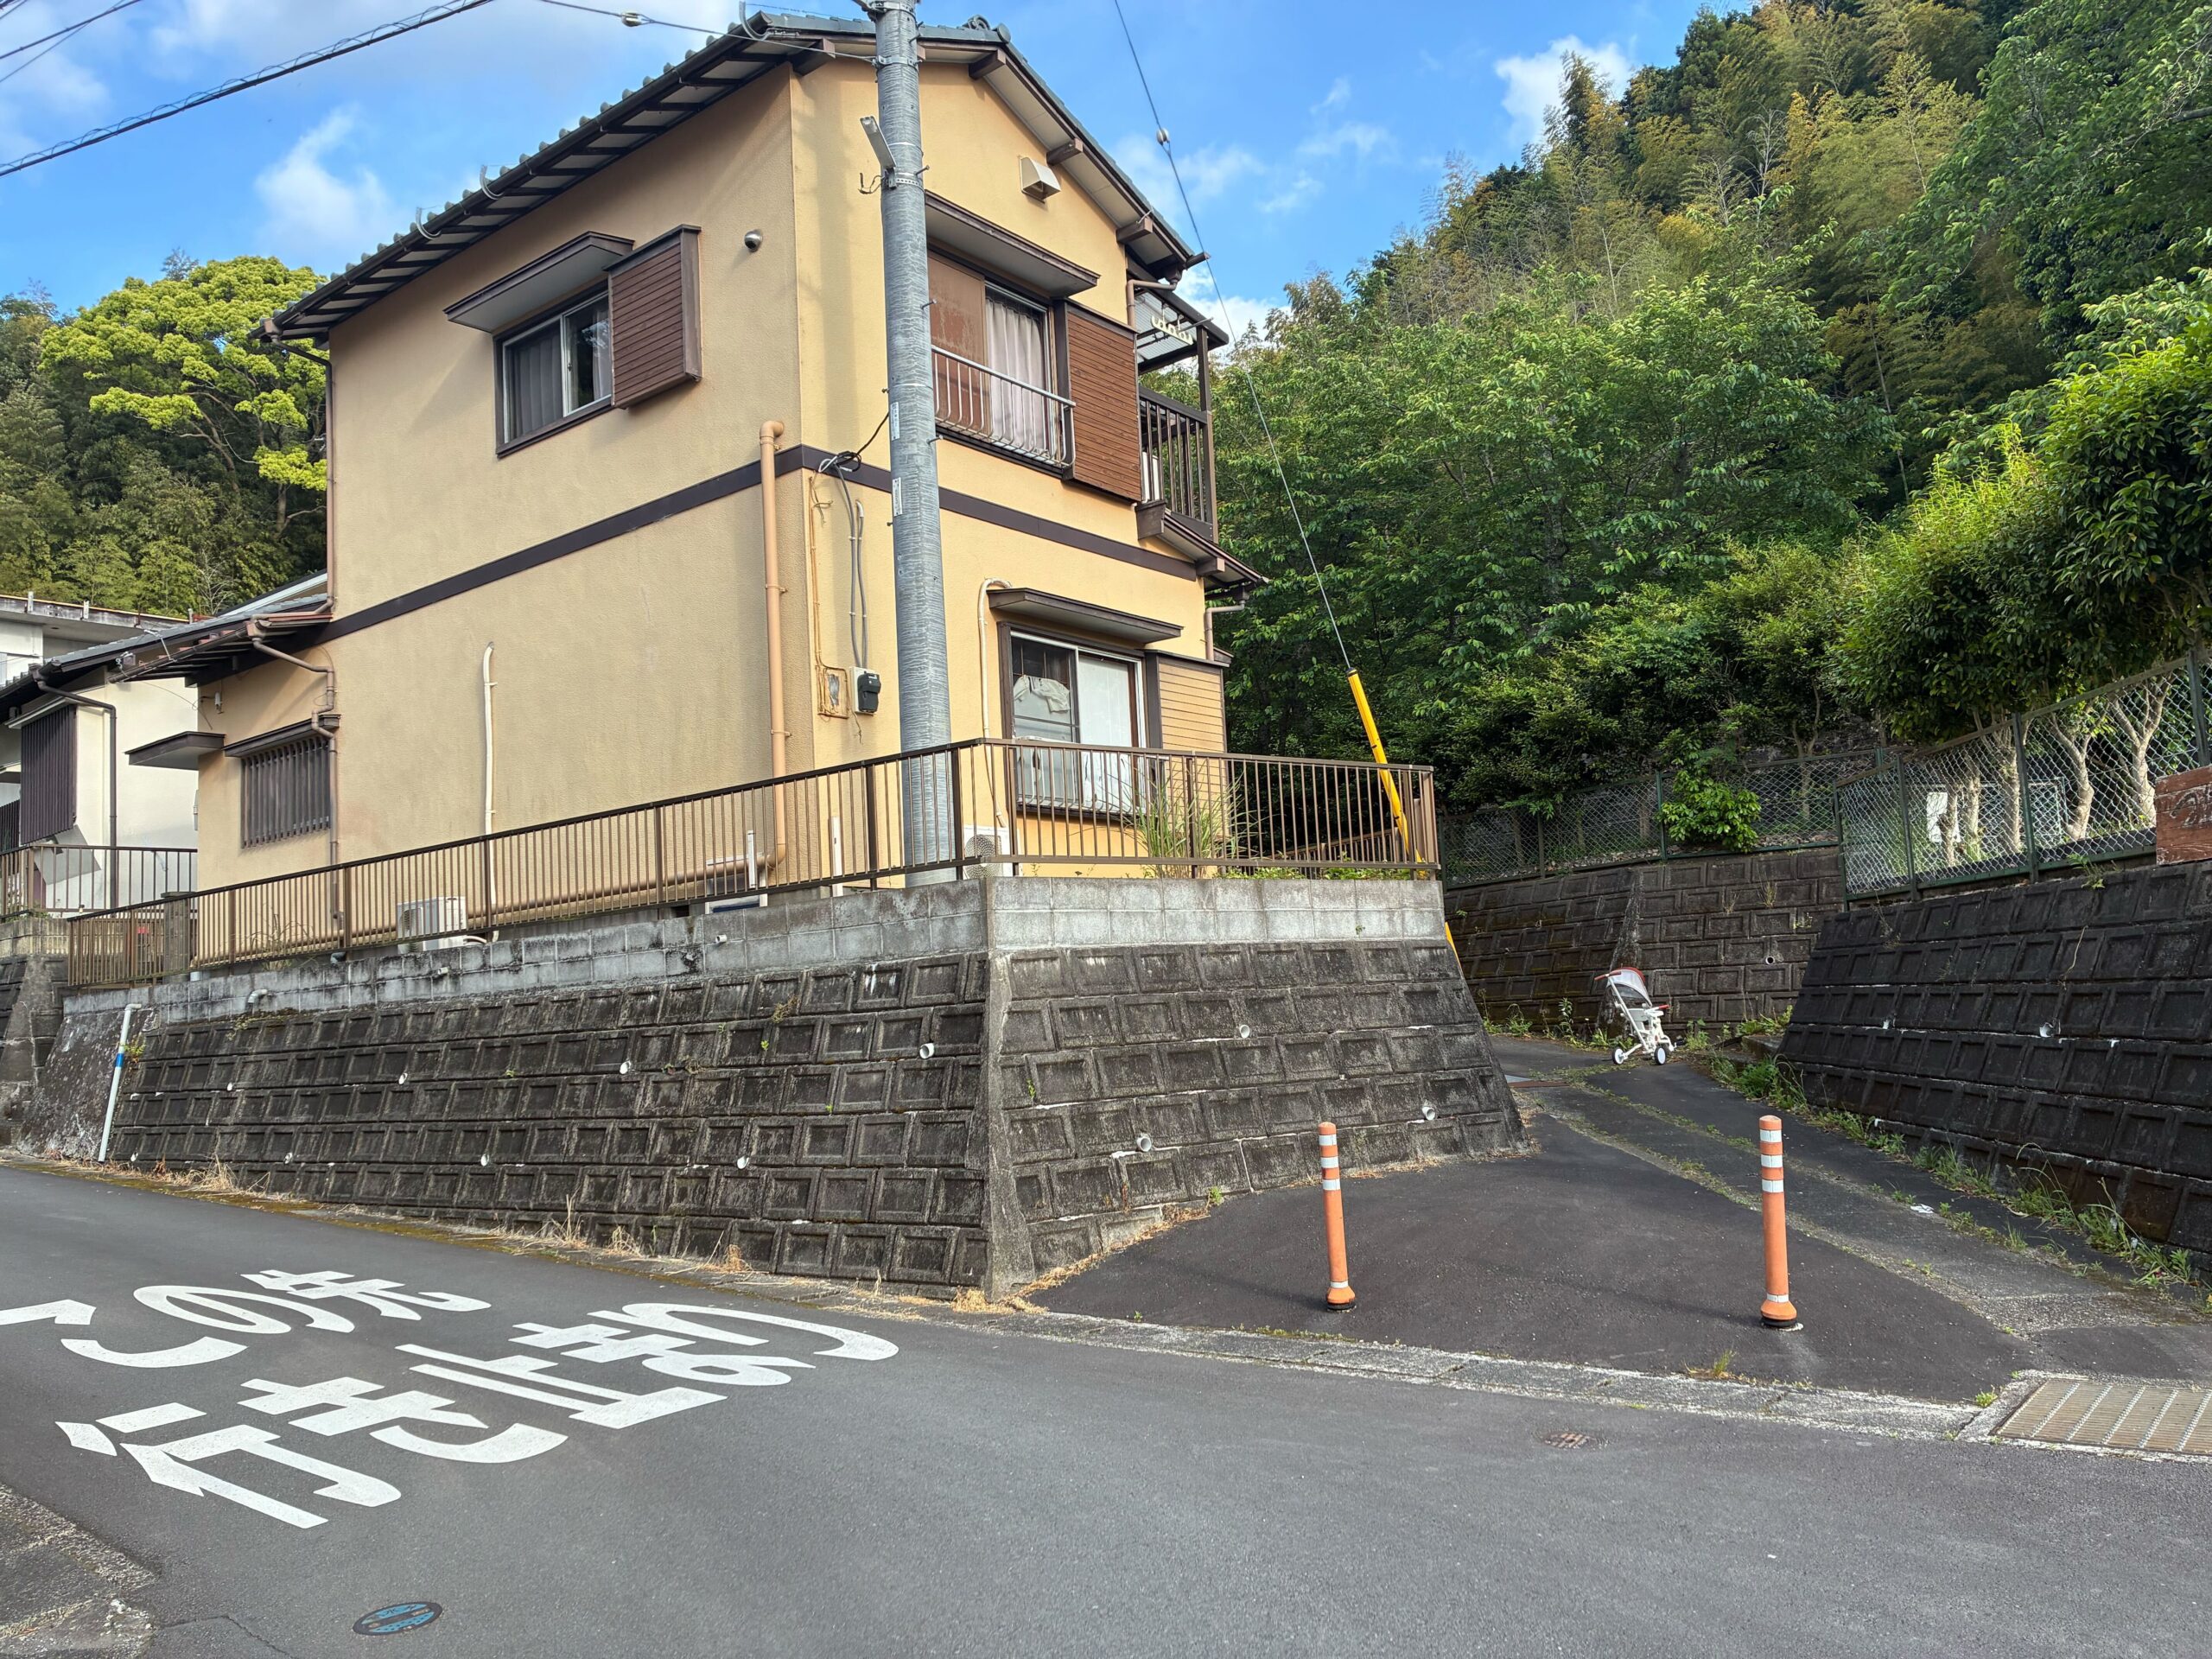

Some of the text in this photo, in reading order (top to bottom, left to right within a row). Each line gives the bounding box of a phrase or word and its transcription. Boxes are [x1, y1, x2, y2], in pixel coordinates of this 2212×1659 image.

[0, 1269, 493, 1369] この先
[54, 1302, 899, 1529] 行き止まり
